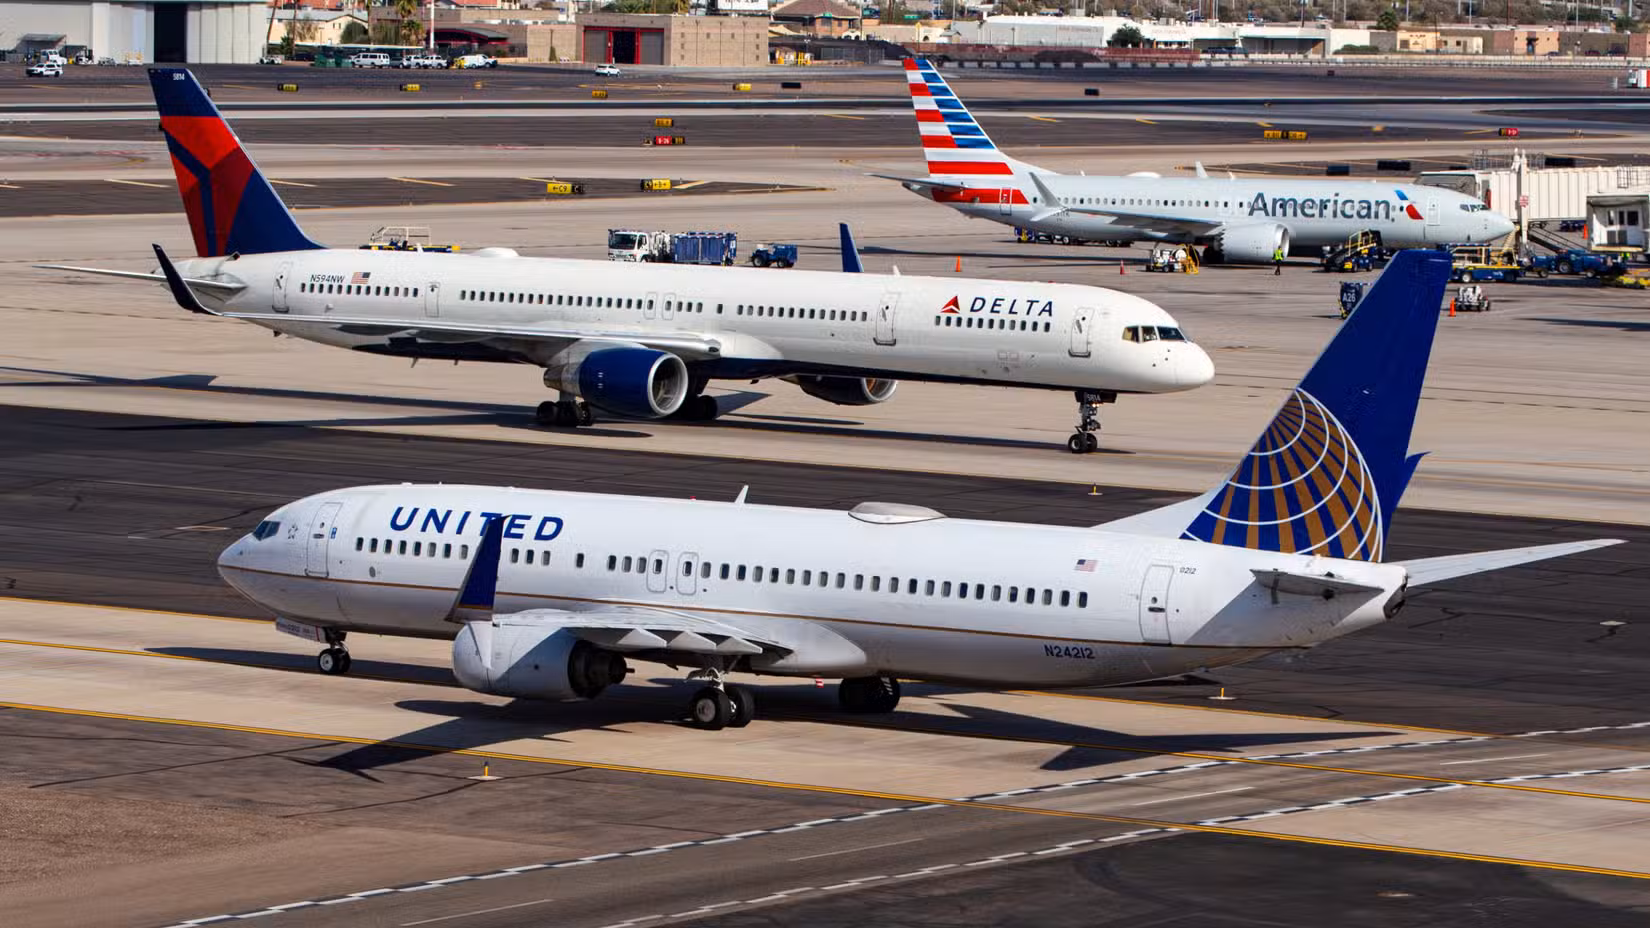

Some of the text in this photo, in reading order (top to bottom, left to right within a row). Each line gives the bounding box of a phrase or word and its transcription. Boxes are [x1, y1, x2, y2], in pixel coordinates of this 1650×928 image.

[558, 185, 568, 193] C9
[1248, 192, 1391, 219] American
[310, 274, 345, 284] N594NW
[1342, 292, 1356, 302] A26
[969, 296, 1053, 317] DELTA
[389, 506, 564, 541] UNITED
[1043, 644, 1096, 659] N24212
